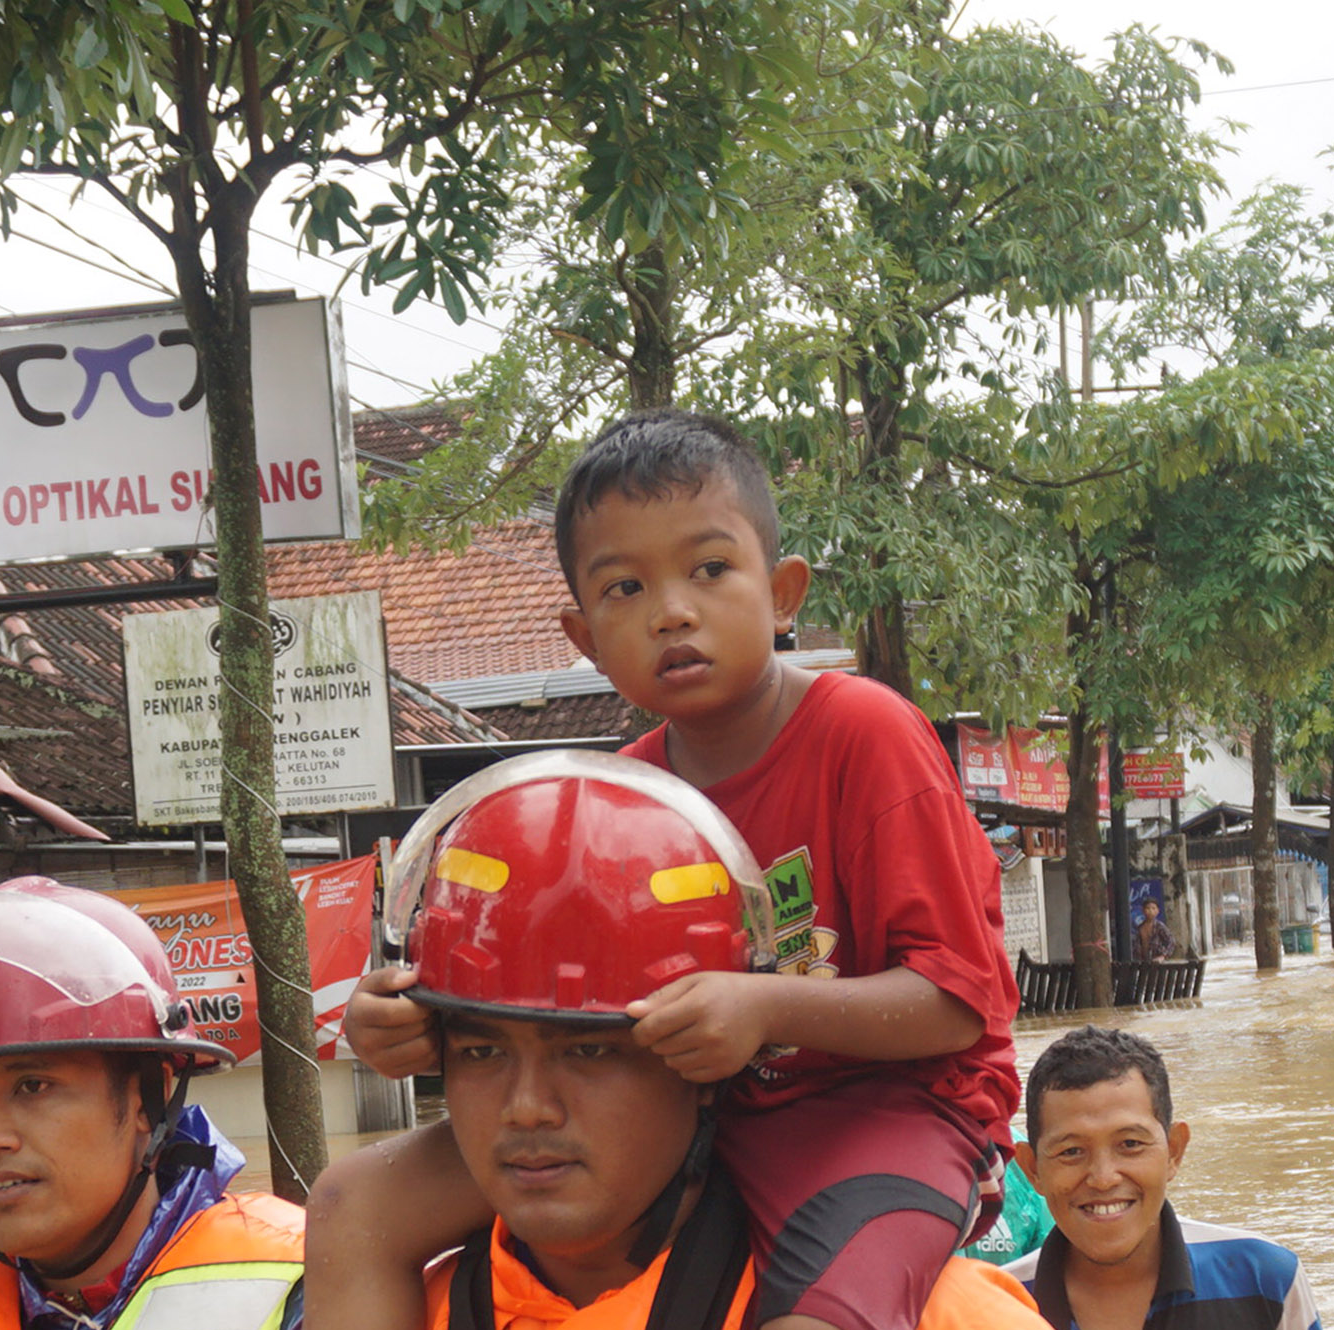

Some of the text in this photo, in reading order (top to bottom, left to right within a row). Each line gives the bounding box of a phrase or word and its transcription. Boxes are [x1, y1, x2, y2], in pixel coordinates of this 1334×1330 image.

[3, 458, 323, 527] OPTIKAL SUANG
[155, 676, 208, 691] DEWAN
[294, 662, 357, 679] CABANG
[143, 695, 204, 716] PENYIAR
[290, 681, 372, 703] WAHIDIYAH
[160, 727, 361, 754] KABUPA RENGGALEK
[288, 760, 340, 773] KELUTAN
[147, 912, 217, 954] ayu
[166, 931, 253, 971] ONES
[180, 976, 206, 988] 2022
[183, 994, 243, 1023] ANG
